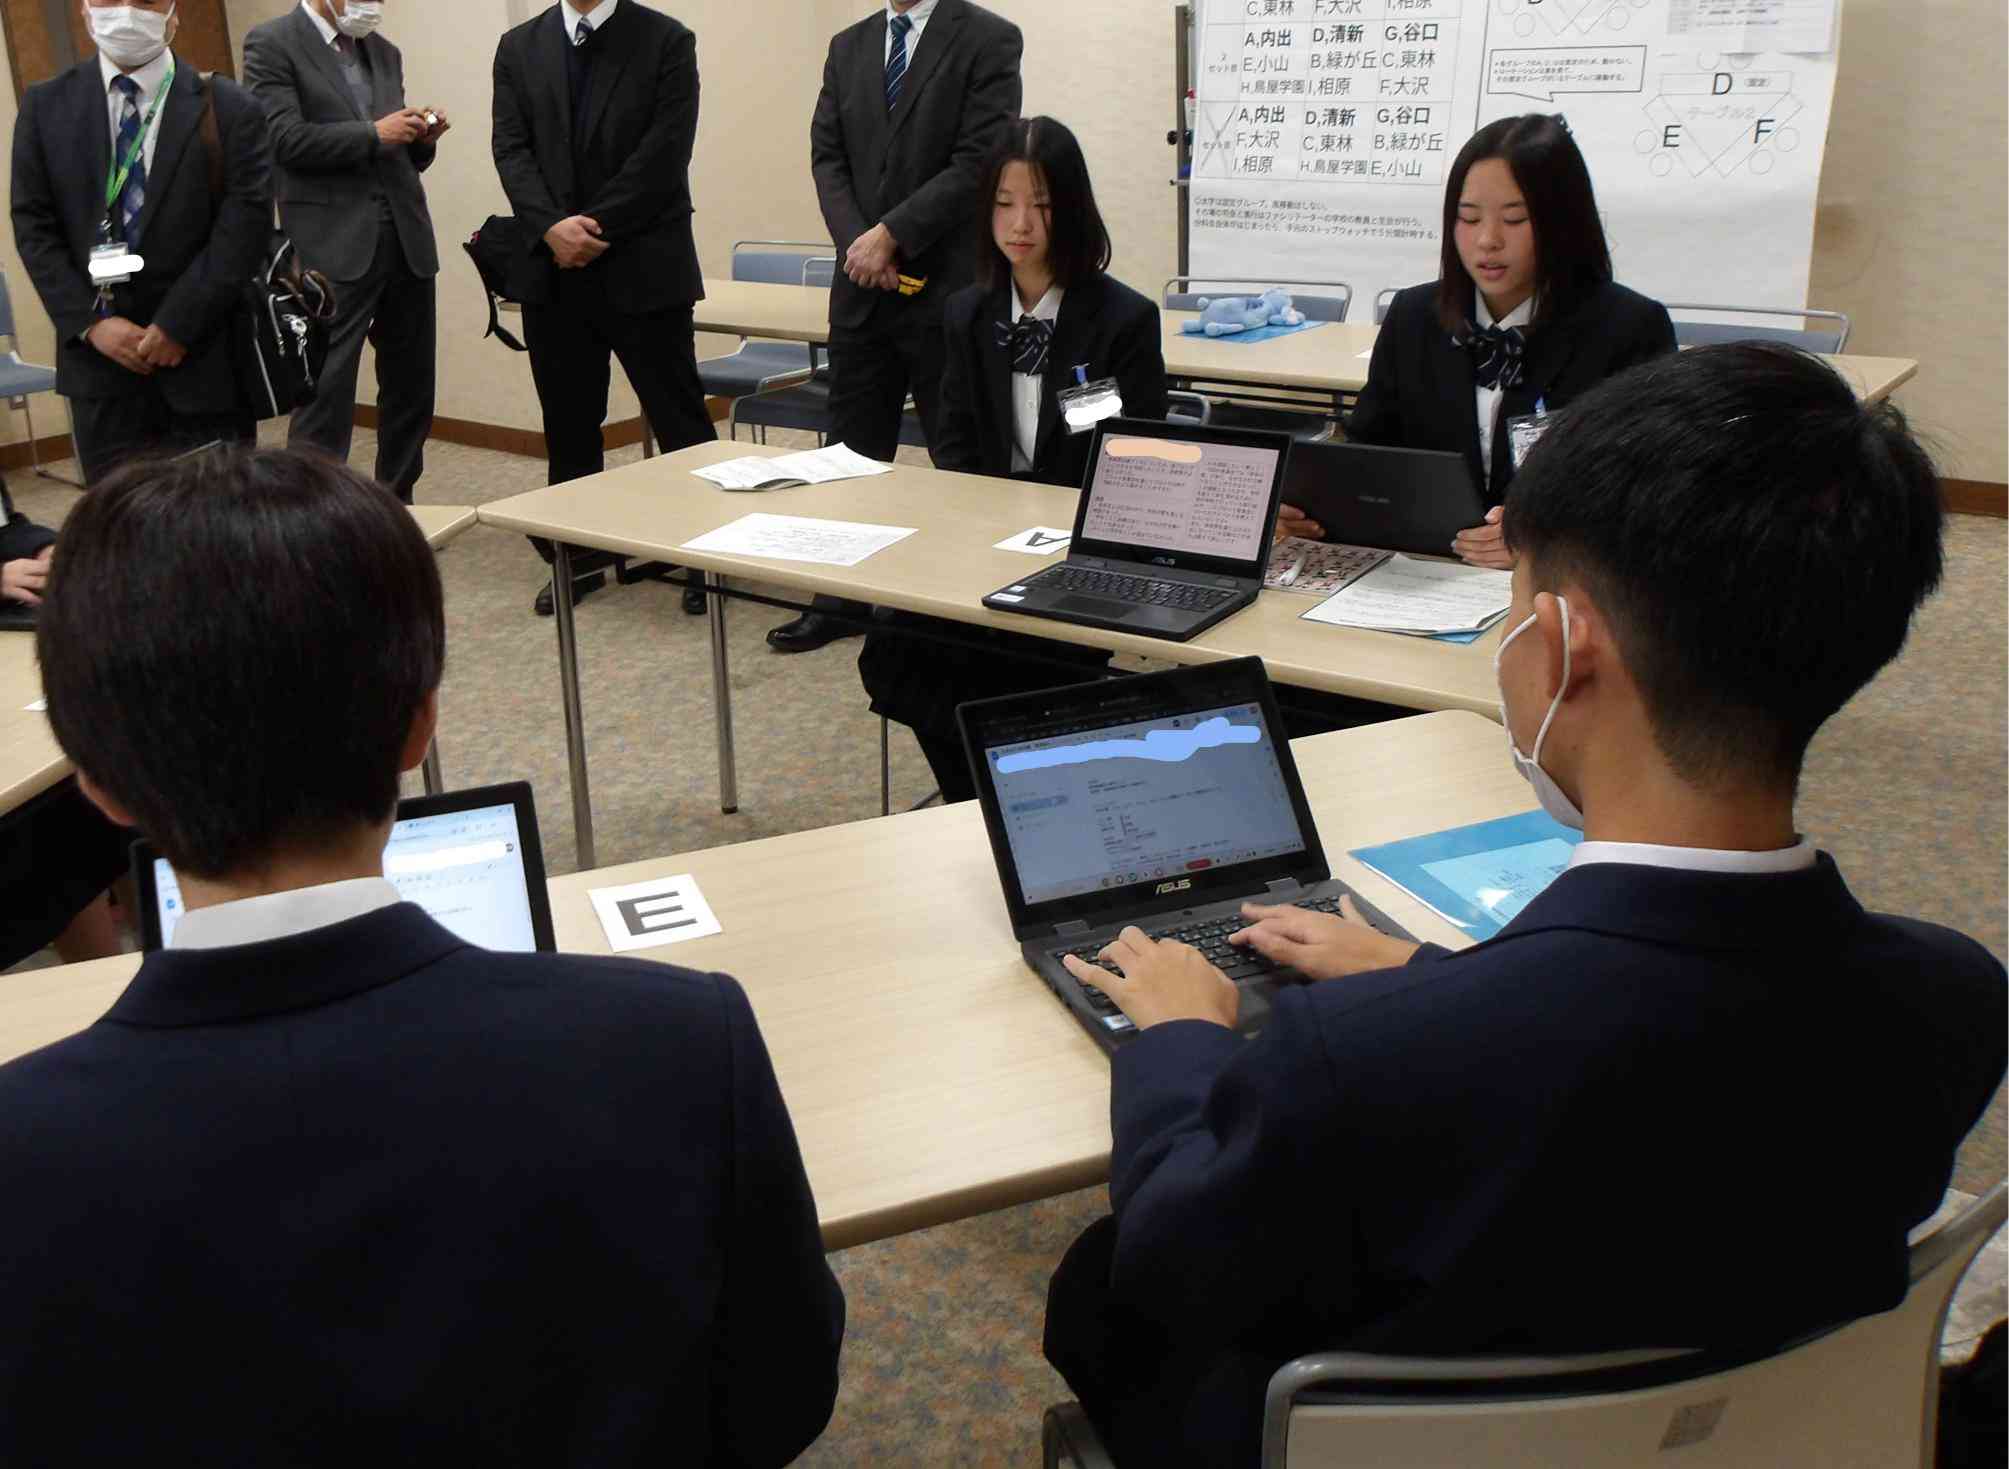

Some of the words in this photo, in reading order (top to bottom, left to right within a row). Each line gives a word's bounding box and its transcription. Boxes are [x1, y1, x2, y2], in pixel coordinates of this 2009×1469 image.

[1247, 0, 1294, 16] C,東林
[1313, 0, 1361, 14] F,大沢
[1244, 29, 1292, 48] A,内出
[1312, 24, 1364, 43] D,清新
[1384, 22, 1438, 43] G,谷口
[1242, 54, 1289, 73] E,小山
[1310, 50, 1377, 70] B,緑が丘
[1382, 50, 1435, 68] C,東林
[1308, 76, 1352, 96] I,相原
[1379, 75, 1430, 96] F,大沢
[1711, 72, 1733, 95] D
[1237, 105, 1285, 124] A,内出
[1304, 107, 1356, 128] D,清新
[1377, 105, 1431, 126] G,谷口
[1236, 130, 1280, 149] F,大沢
[1662, 124, 1682, 147] E
[1753, 119, 1775, 144] F
[1302, 133, 1353, 152] C,東林
[1374, 132, 1444, 152] B,緑が丘
[1232, 155, 1273, 174] I,相原
[1370, 157, 1422, 178] E,小山
[1024, 531, 1072, 547] A
[1155, 879, 1192, 896] ASUS
[616, 891, 697, 936] E
